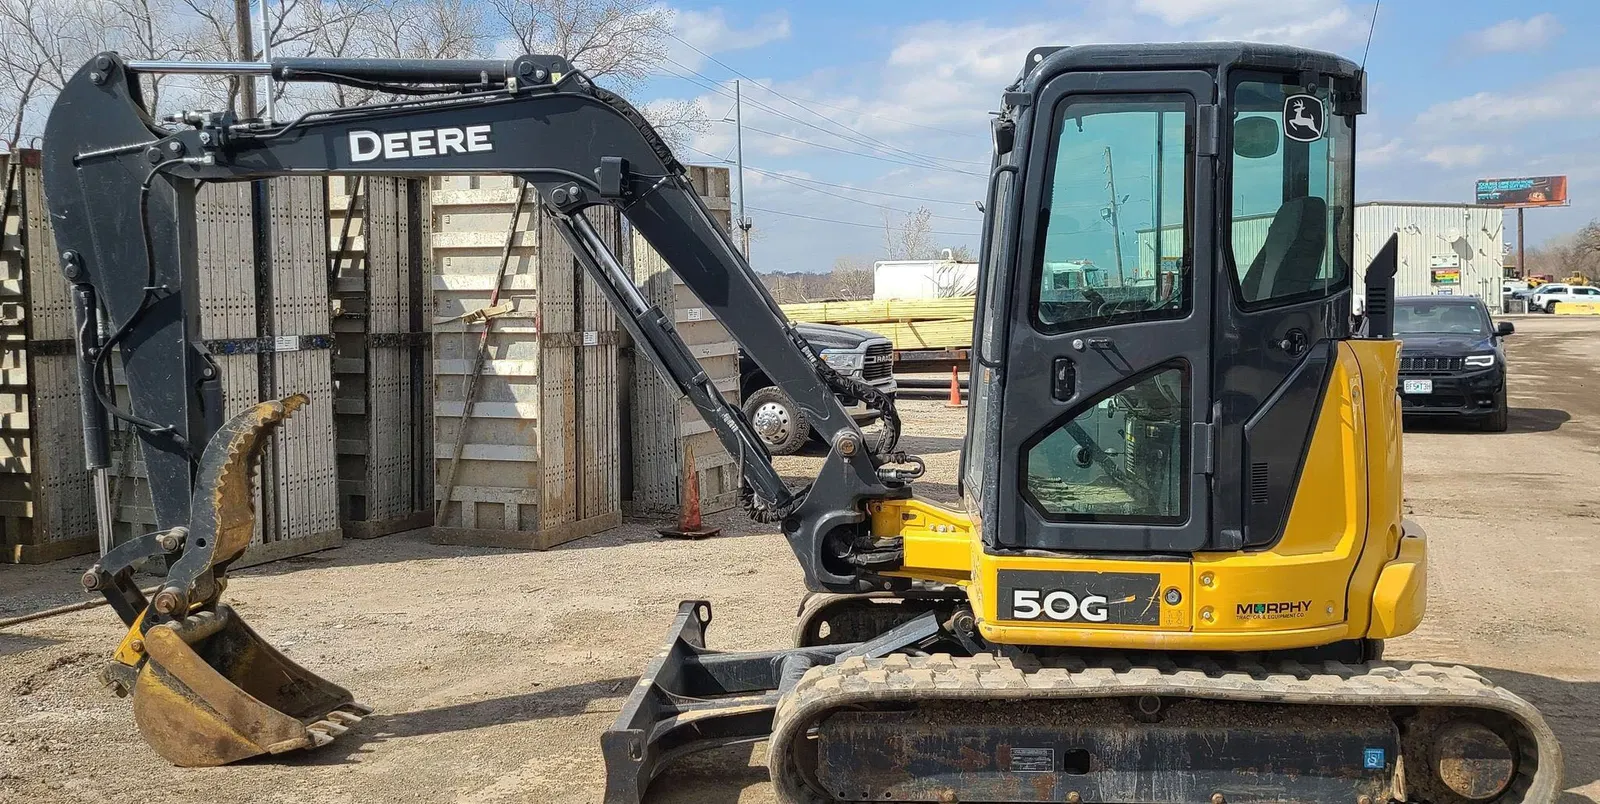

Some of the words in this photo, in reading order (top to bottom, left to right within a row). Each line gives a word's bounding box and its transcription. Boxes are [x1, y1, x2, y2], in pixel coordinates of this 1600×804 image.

[349, 125, 493, 162] DEERE
[877, 355, 889, 363] RAM
[1013, 590, 1108, 622] 50G
[1236, 600, 1312, 614] MURPHY
